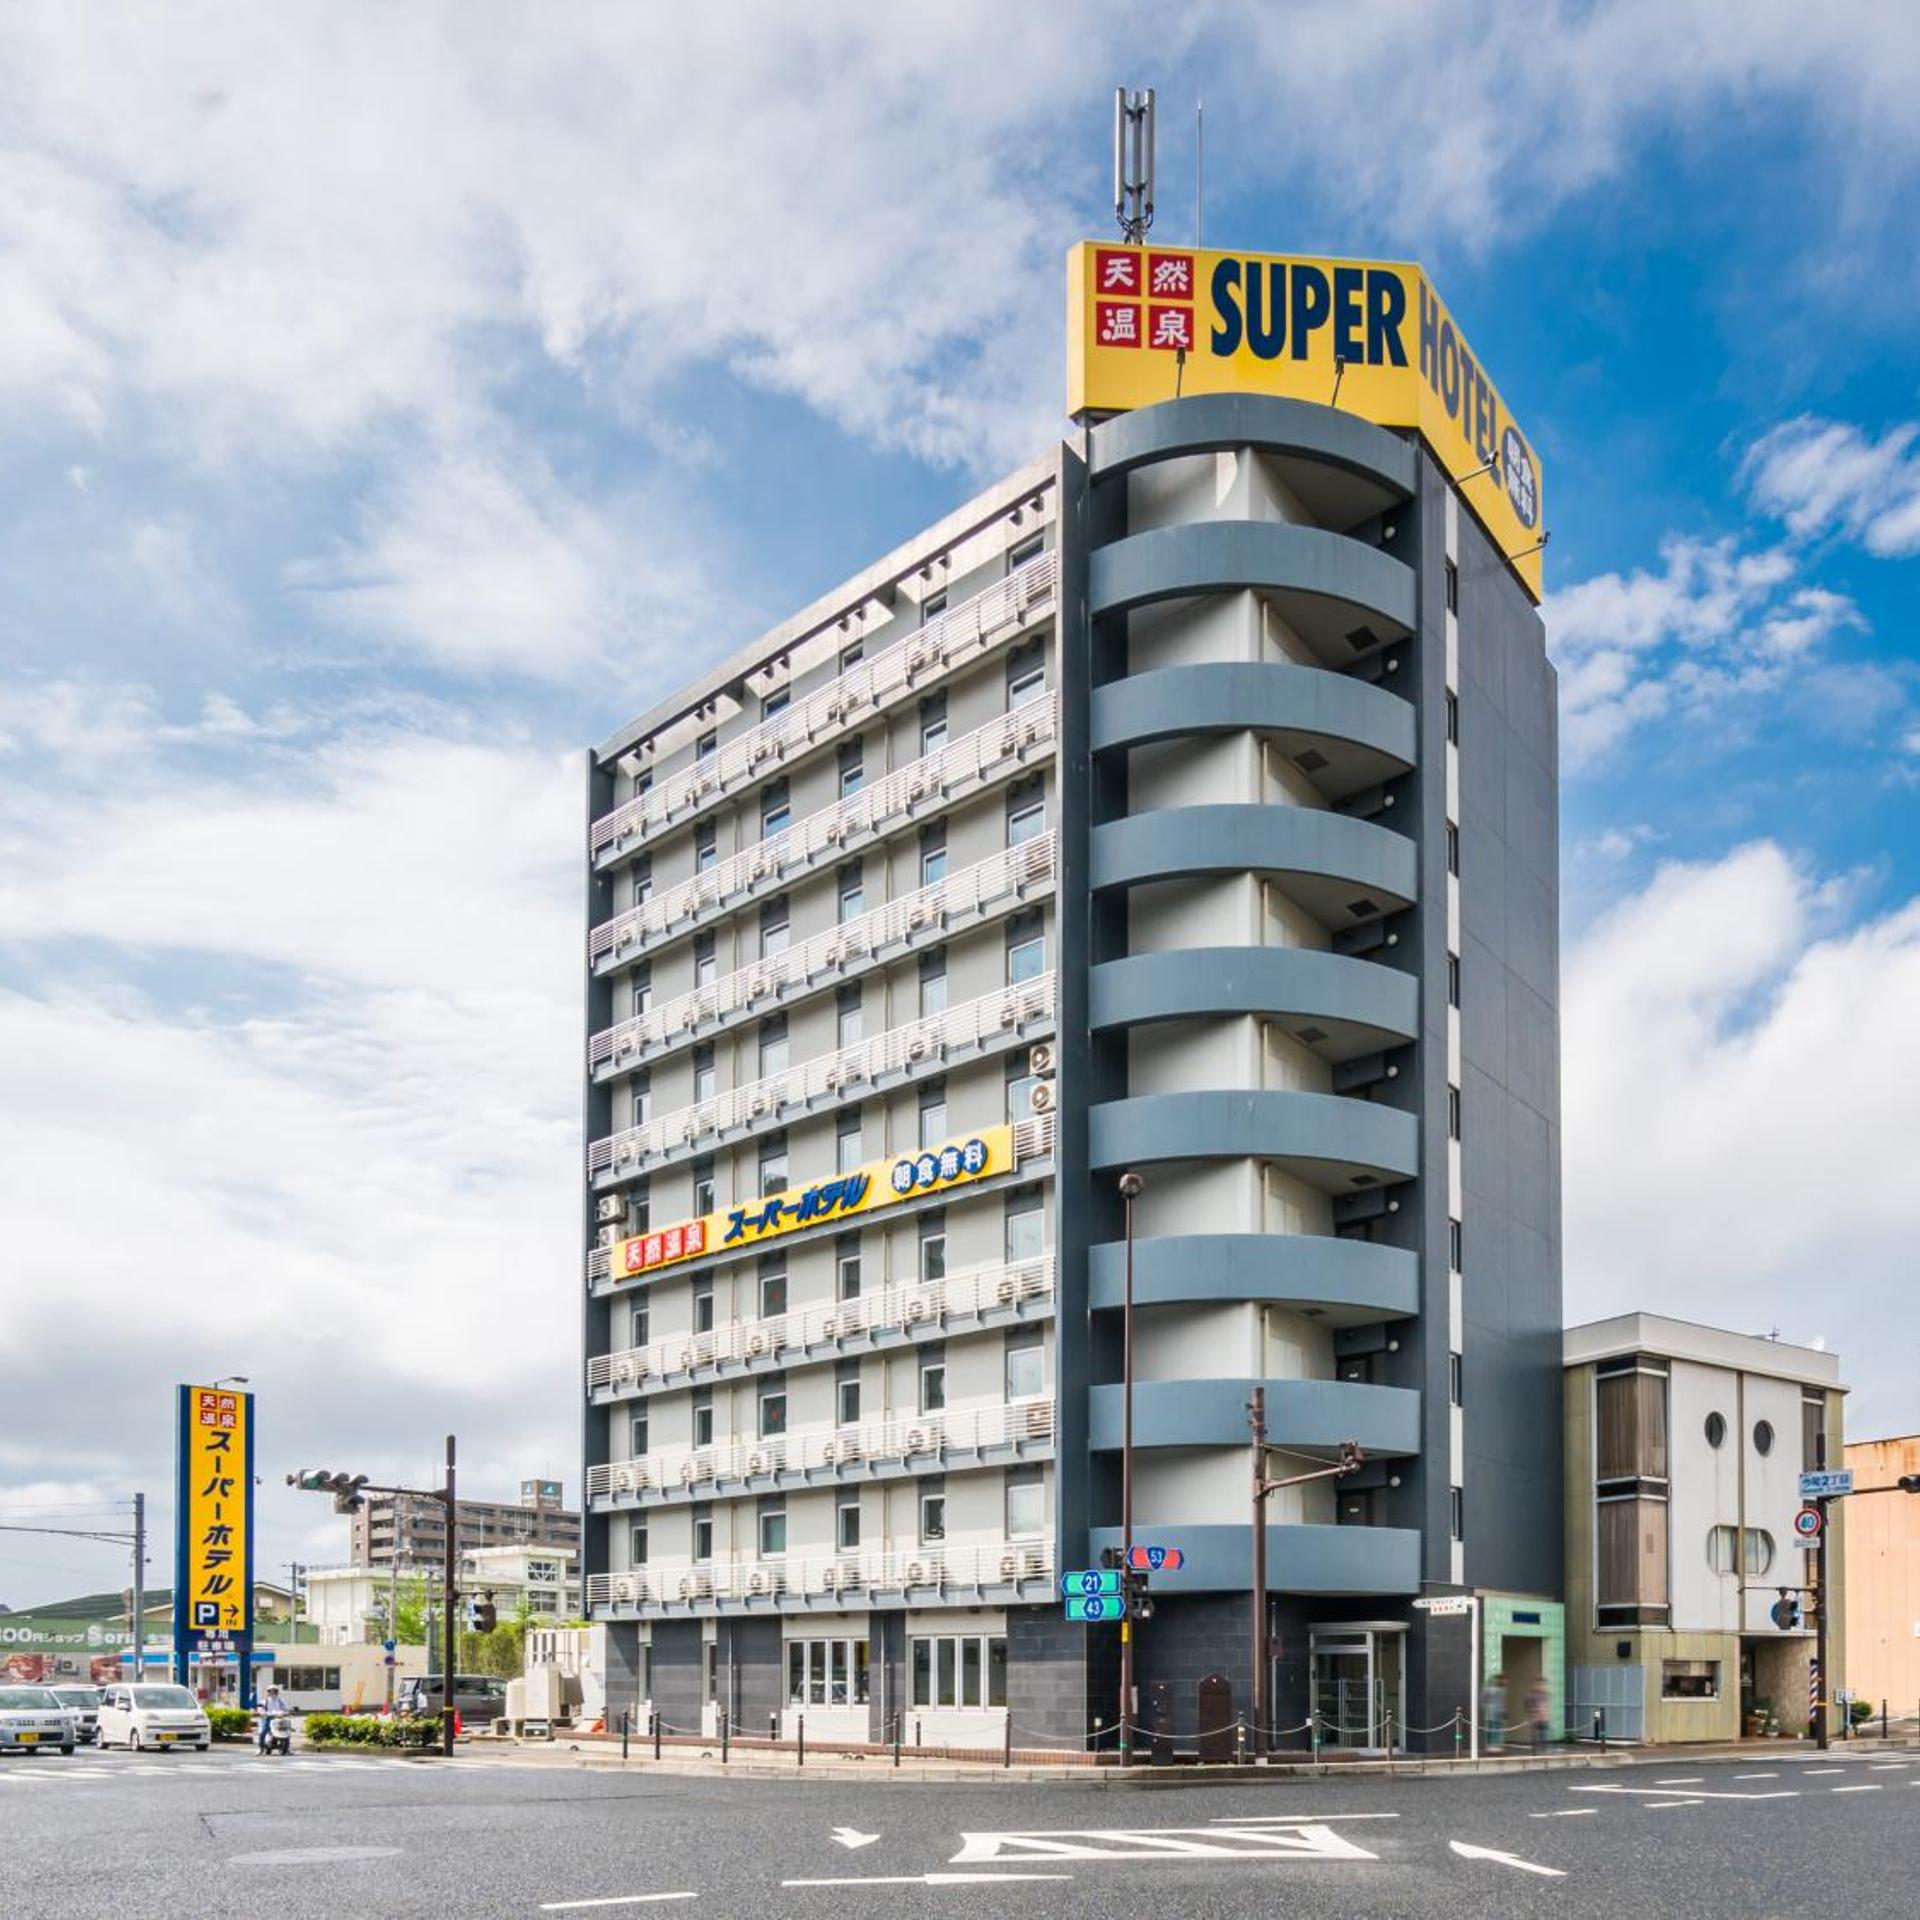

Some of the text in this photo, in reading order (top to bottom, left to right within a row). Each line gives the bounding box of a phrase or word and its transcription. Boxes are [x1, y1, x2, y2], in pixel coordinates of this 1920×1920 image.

[1104, 256, 1189, 293] 天然
[1101, 307, 1190, 346] 温泉
[1211, 258, 1501, 490] SUPER HOTEL
[629, 1142, 984, 1270] 天然温泉 スーパーホテル 朝食無料
[203, 1431, 234, 1595] スーパーホテル
[1150, 1550, 1162, 1563] 53
[1085, 1576, 1098, 1591] 21
[198, 1603, 216, 1624] P
[1086, 1601, 1100, 1615] 43
